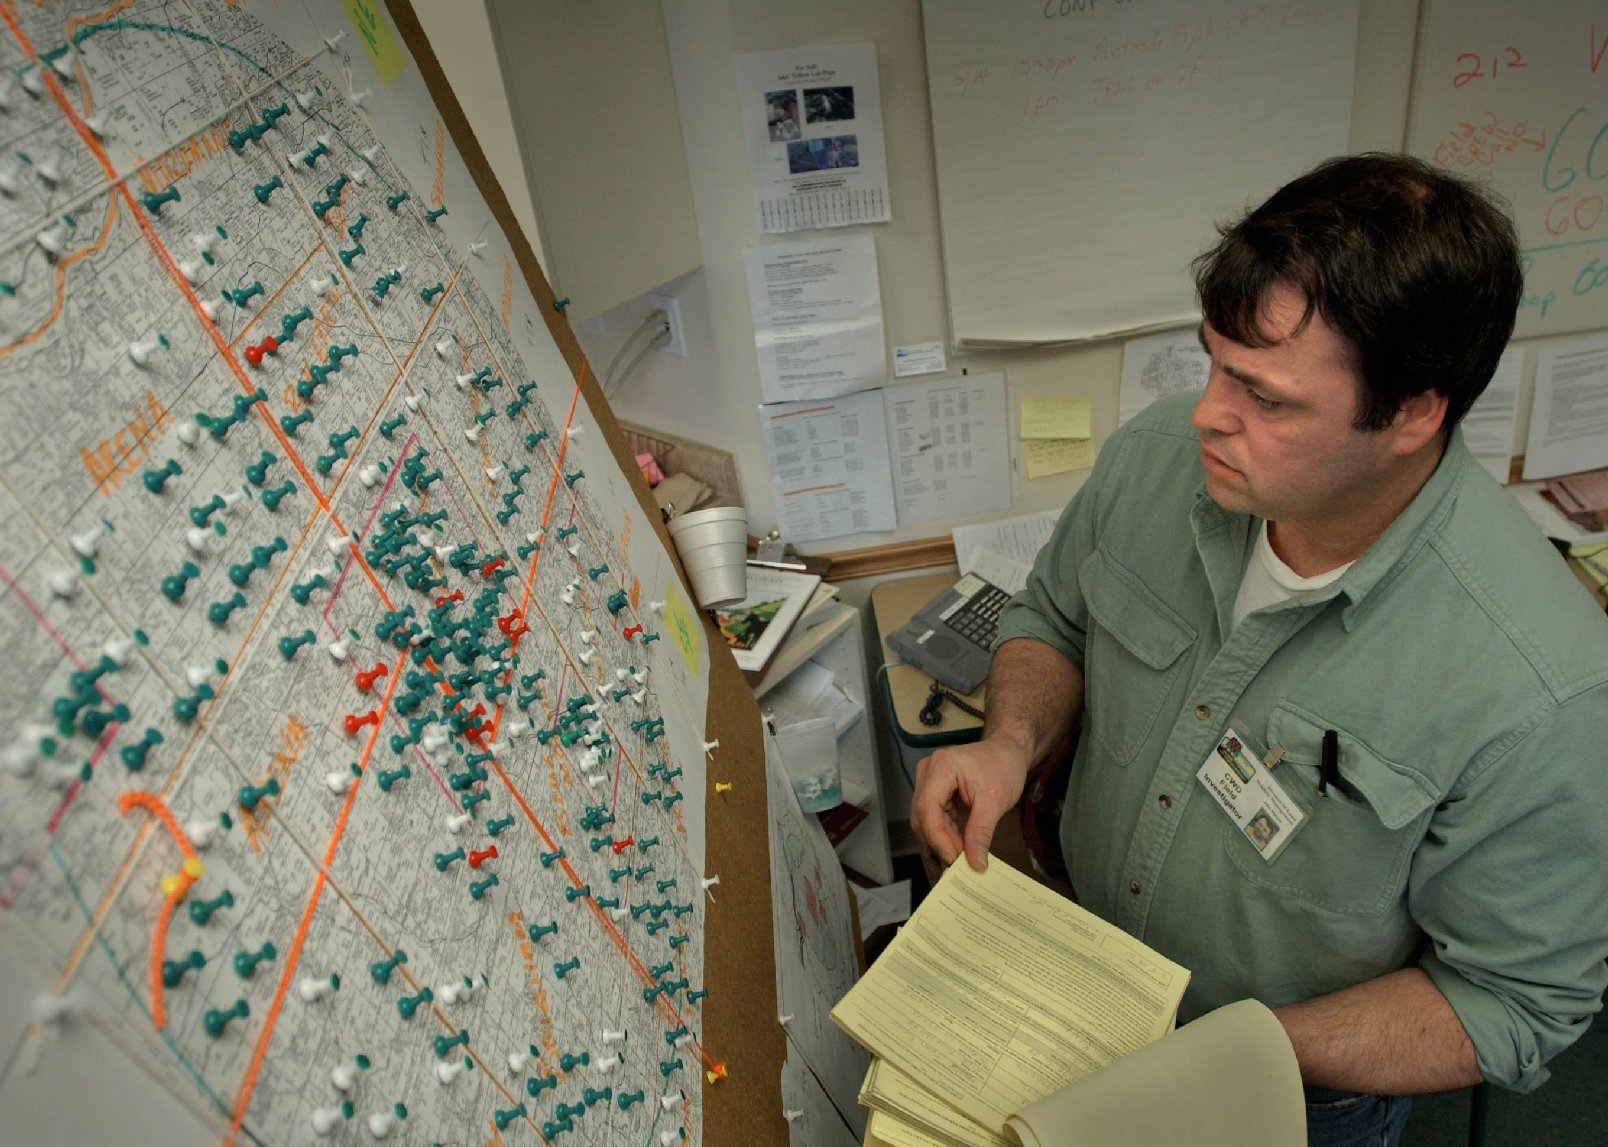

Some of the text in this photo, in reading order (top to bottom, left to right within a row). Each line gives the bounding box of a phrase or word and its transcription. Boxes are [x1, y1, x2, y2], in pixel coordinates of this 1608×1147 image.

[1220, 779, 1238, 801] Field
[1224, 772, 1242, 794] CWD
[1203, 772, 1243, 820] Investigator
